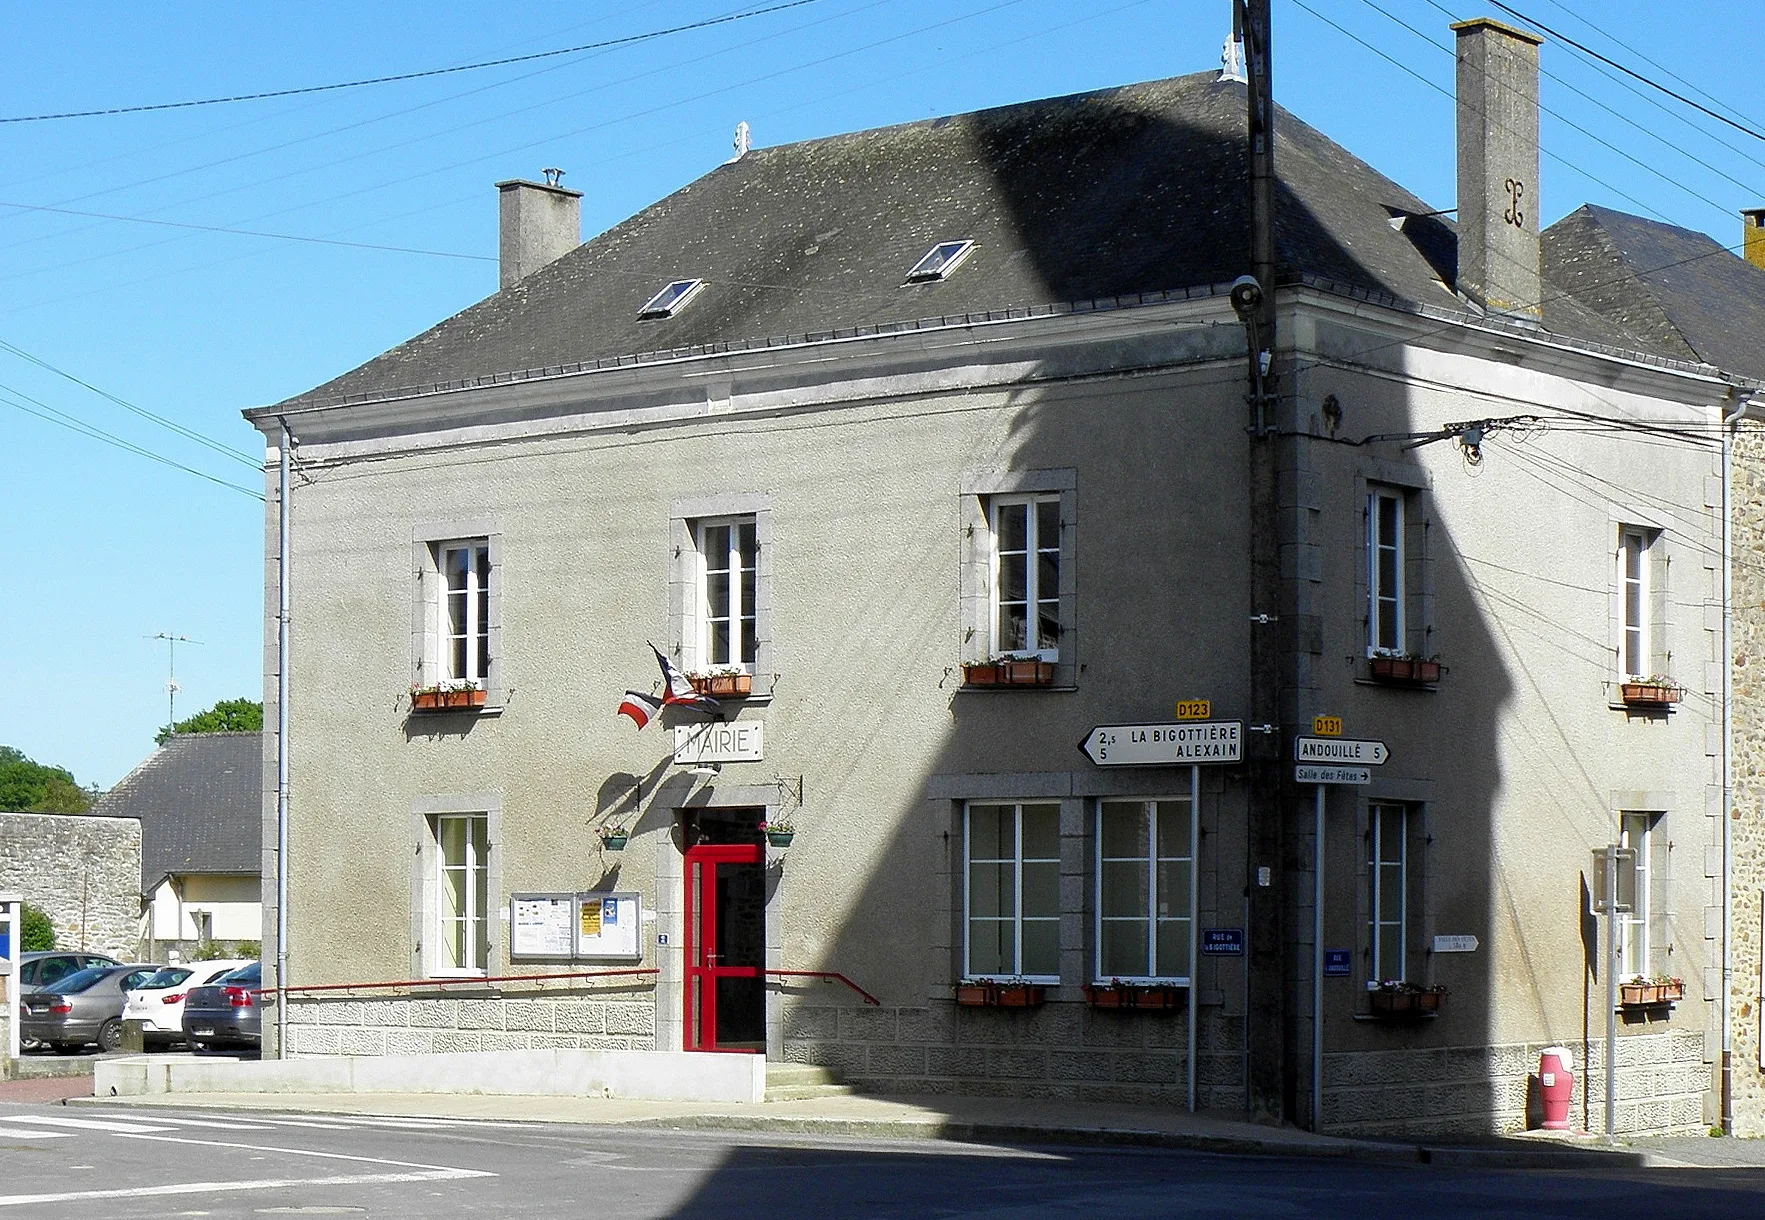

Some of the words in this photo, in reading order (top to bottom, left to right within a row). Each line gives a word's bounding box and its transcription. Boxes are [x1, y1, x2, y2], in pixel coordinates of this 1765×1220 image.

[1179, 704, 1208, 716] D123
[1316, 720, 1340, 732] D131
[686, 729, 749, 753] MAIRIE
[1132, 731, 1147, 743] LA
[1153, 725, 1237, 742] BIGOTTIÈRE
[1100, 748, 1107, 759] 5
[1176, 744, 1237, 757] ALEXAIN
[1302, 743, 1361, 758] ANDOUILLÉ
[1373, 747, 1380, 759] 5
[1298, 769, 1317, 779] Salle
[1320, 769, 1334, 780] des
[1336, 770, 1357, 781] Fêtes
